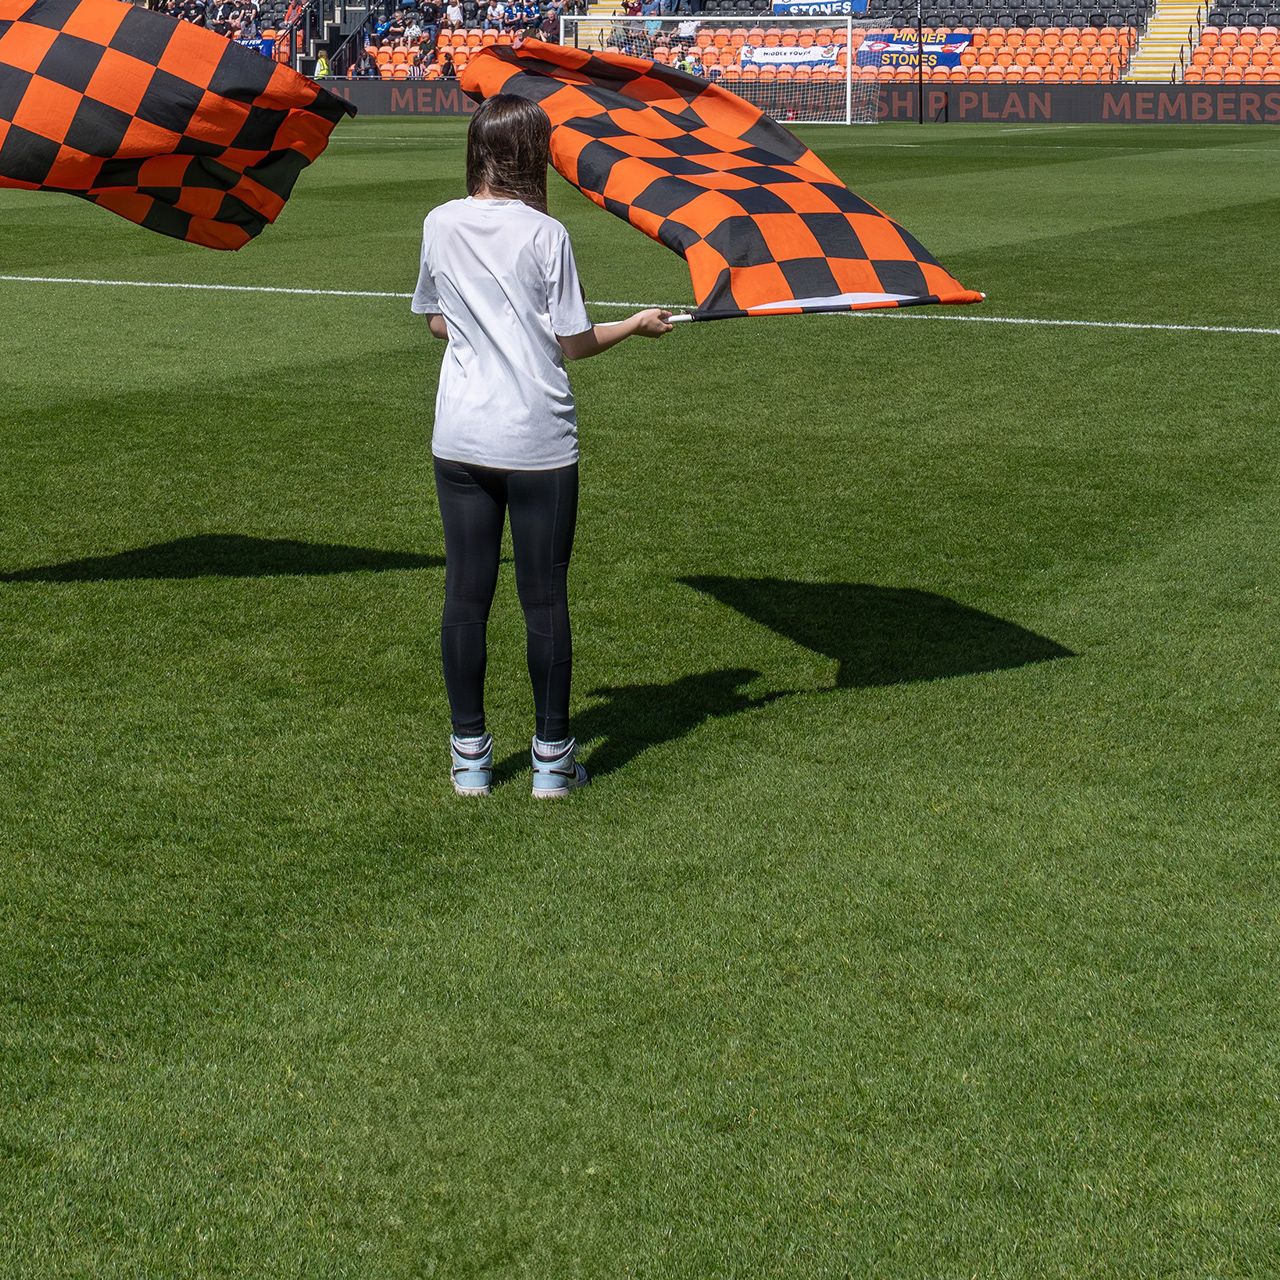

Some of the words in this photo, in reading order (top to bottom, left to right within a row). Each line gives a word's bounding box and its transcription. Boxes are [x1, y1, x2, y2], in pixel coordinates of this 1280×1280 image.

[789, 2, 852, 16] STONES
[893, 33, 947, 43] PINNER
[881, 53, 938, 66] STONES
[959, 91, 1052, 119] PLAN
